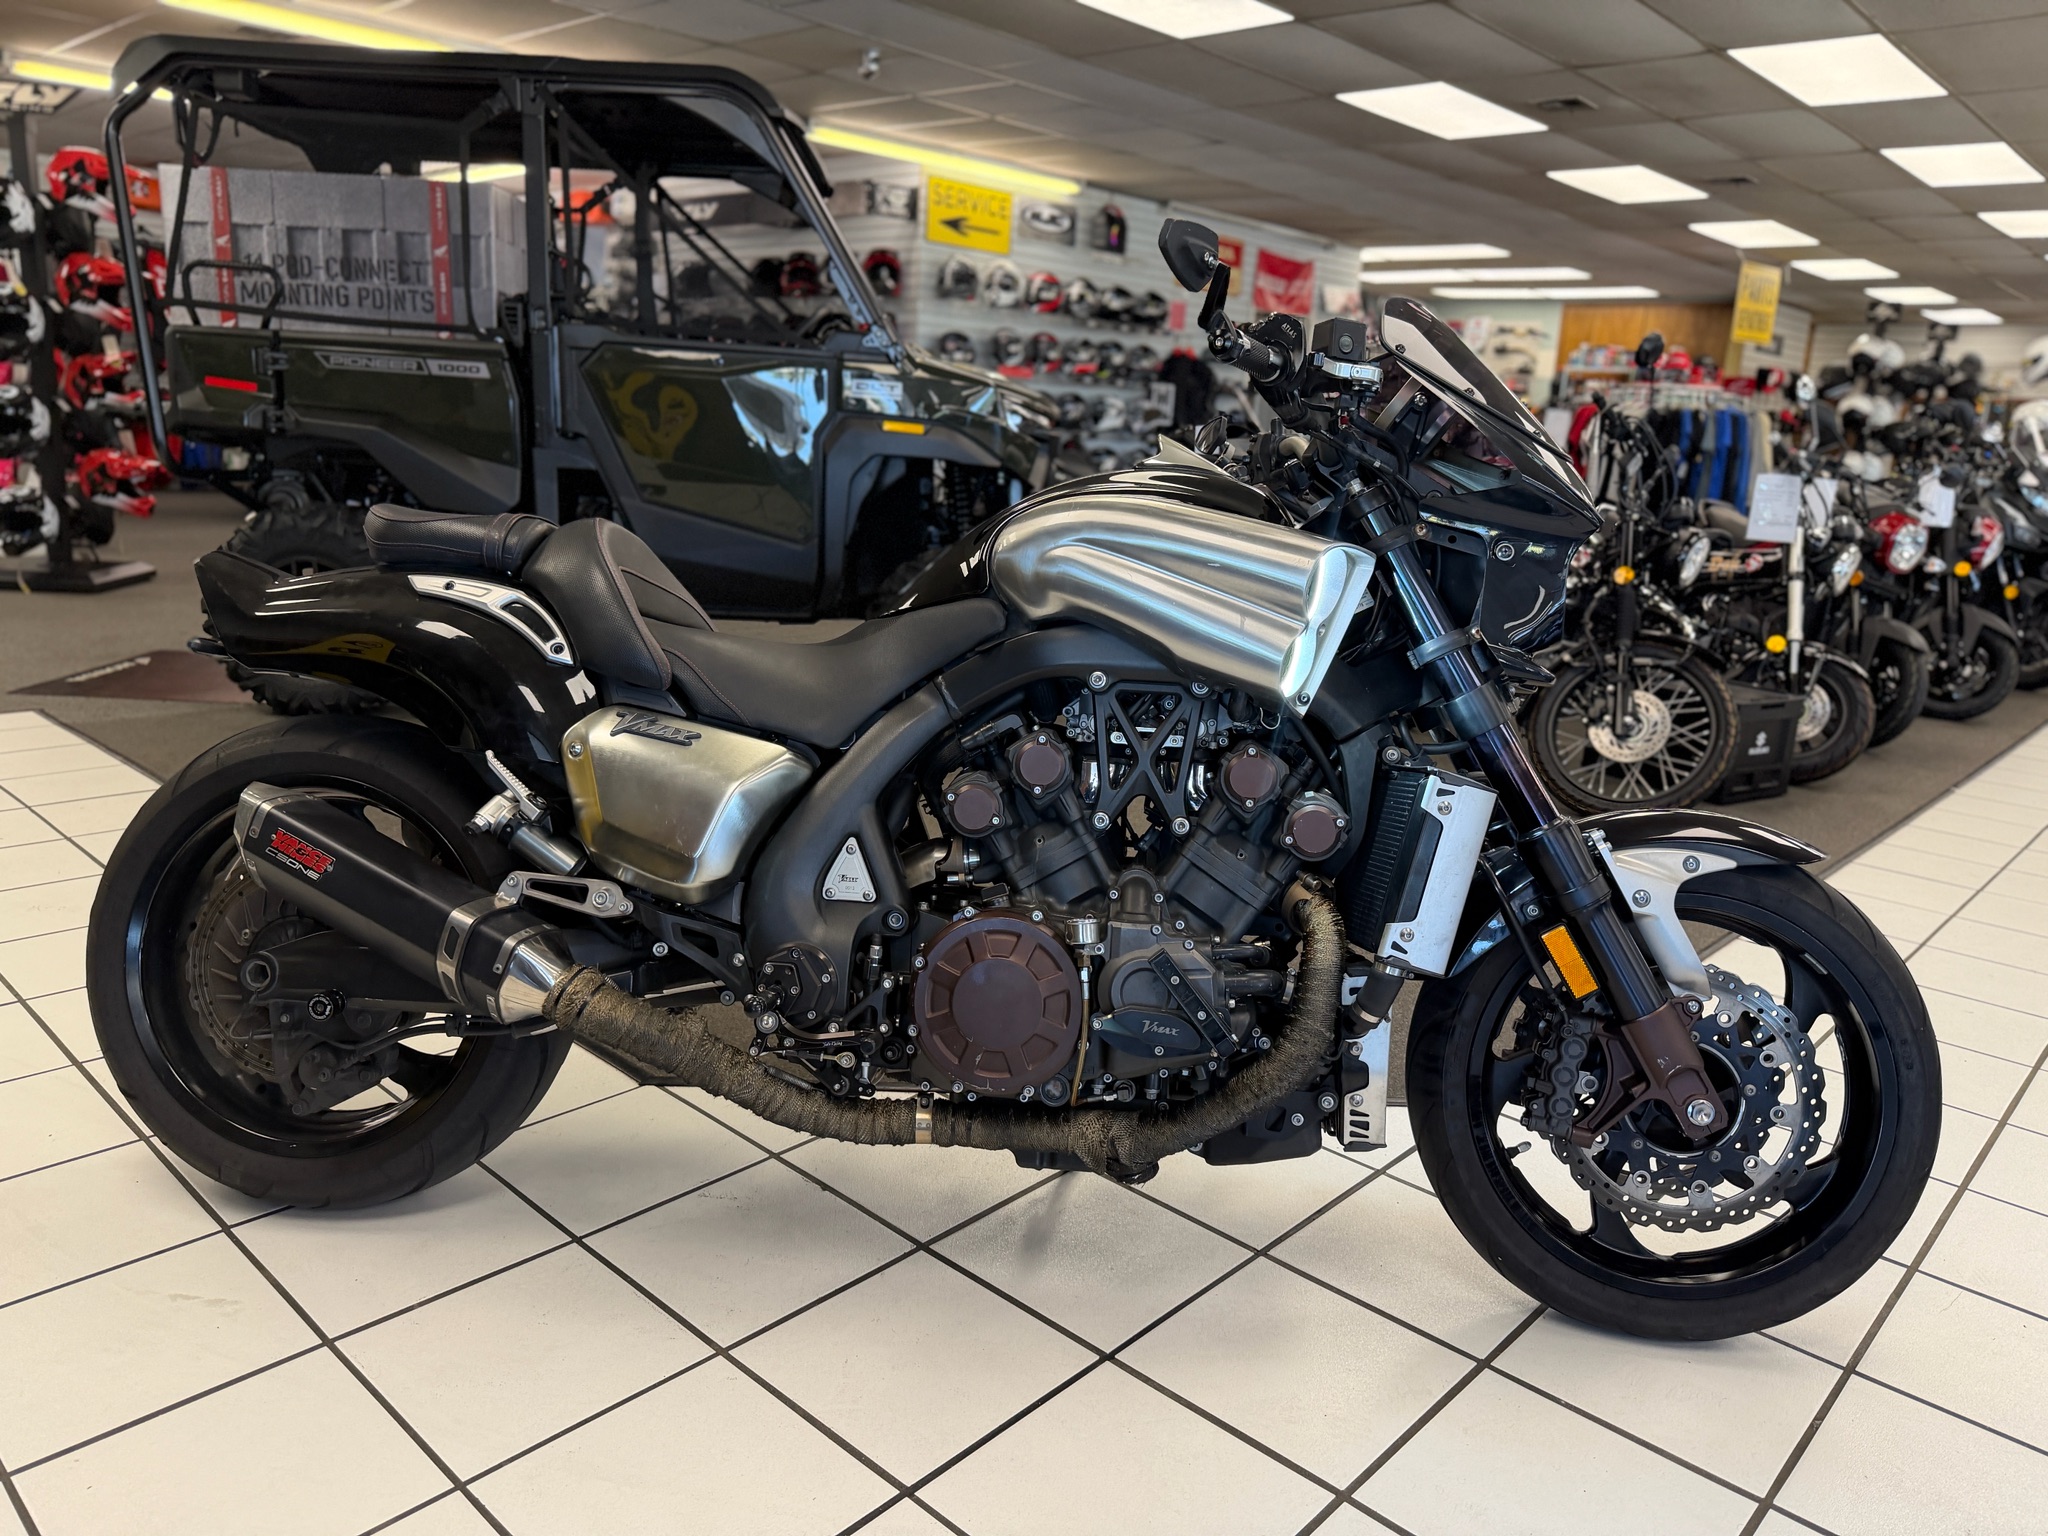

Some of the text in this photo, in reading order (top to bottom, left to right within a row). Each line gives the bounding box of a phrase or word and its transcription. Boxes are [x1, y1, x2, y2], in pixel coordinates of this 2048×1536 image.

[932, 181, 1009, 219] SERVICE
[272, 253, 431, 288] POD-CONNECT
[357, 286, 434, 314] POINTS
[1281, 322, 1297, 339] ATLAS
[329, 354, 481, 375] PIONEER 1000
[271, 838, 326, 874] HINES
[275, 829, 333, 867] VANCE
